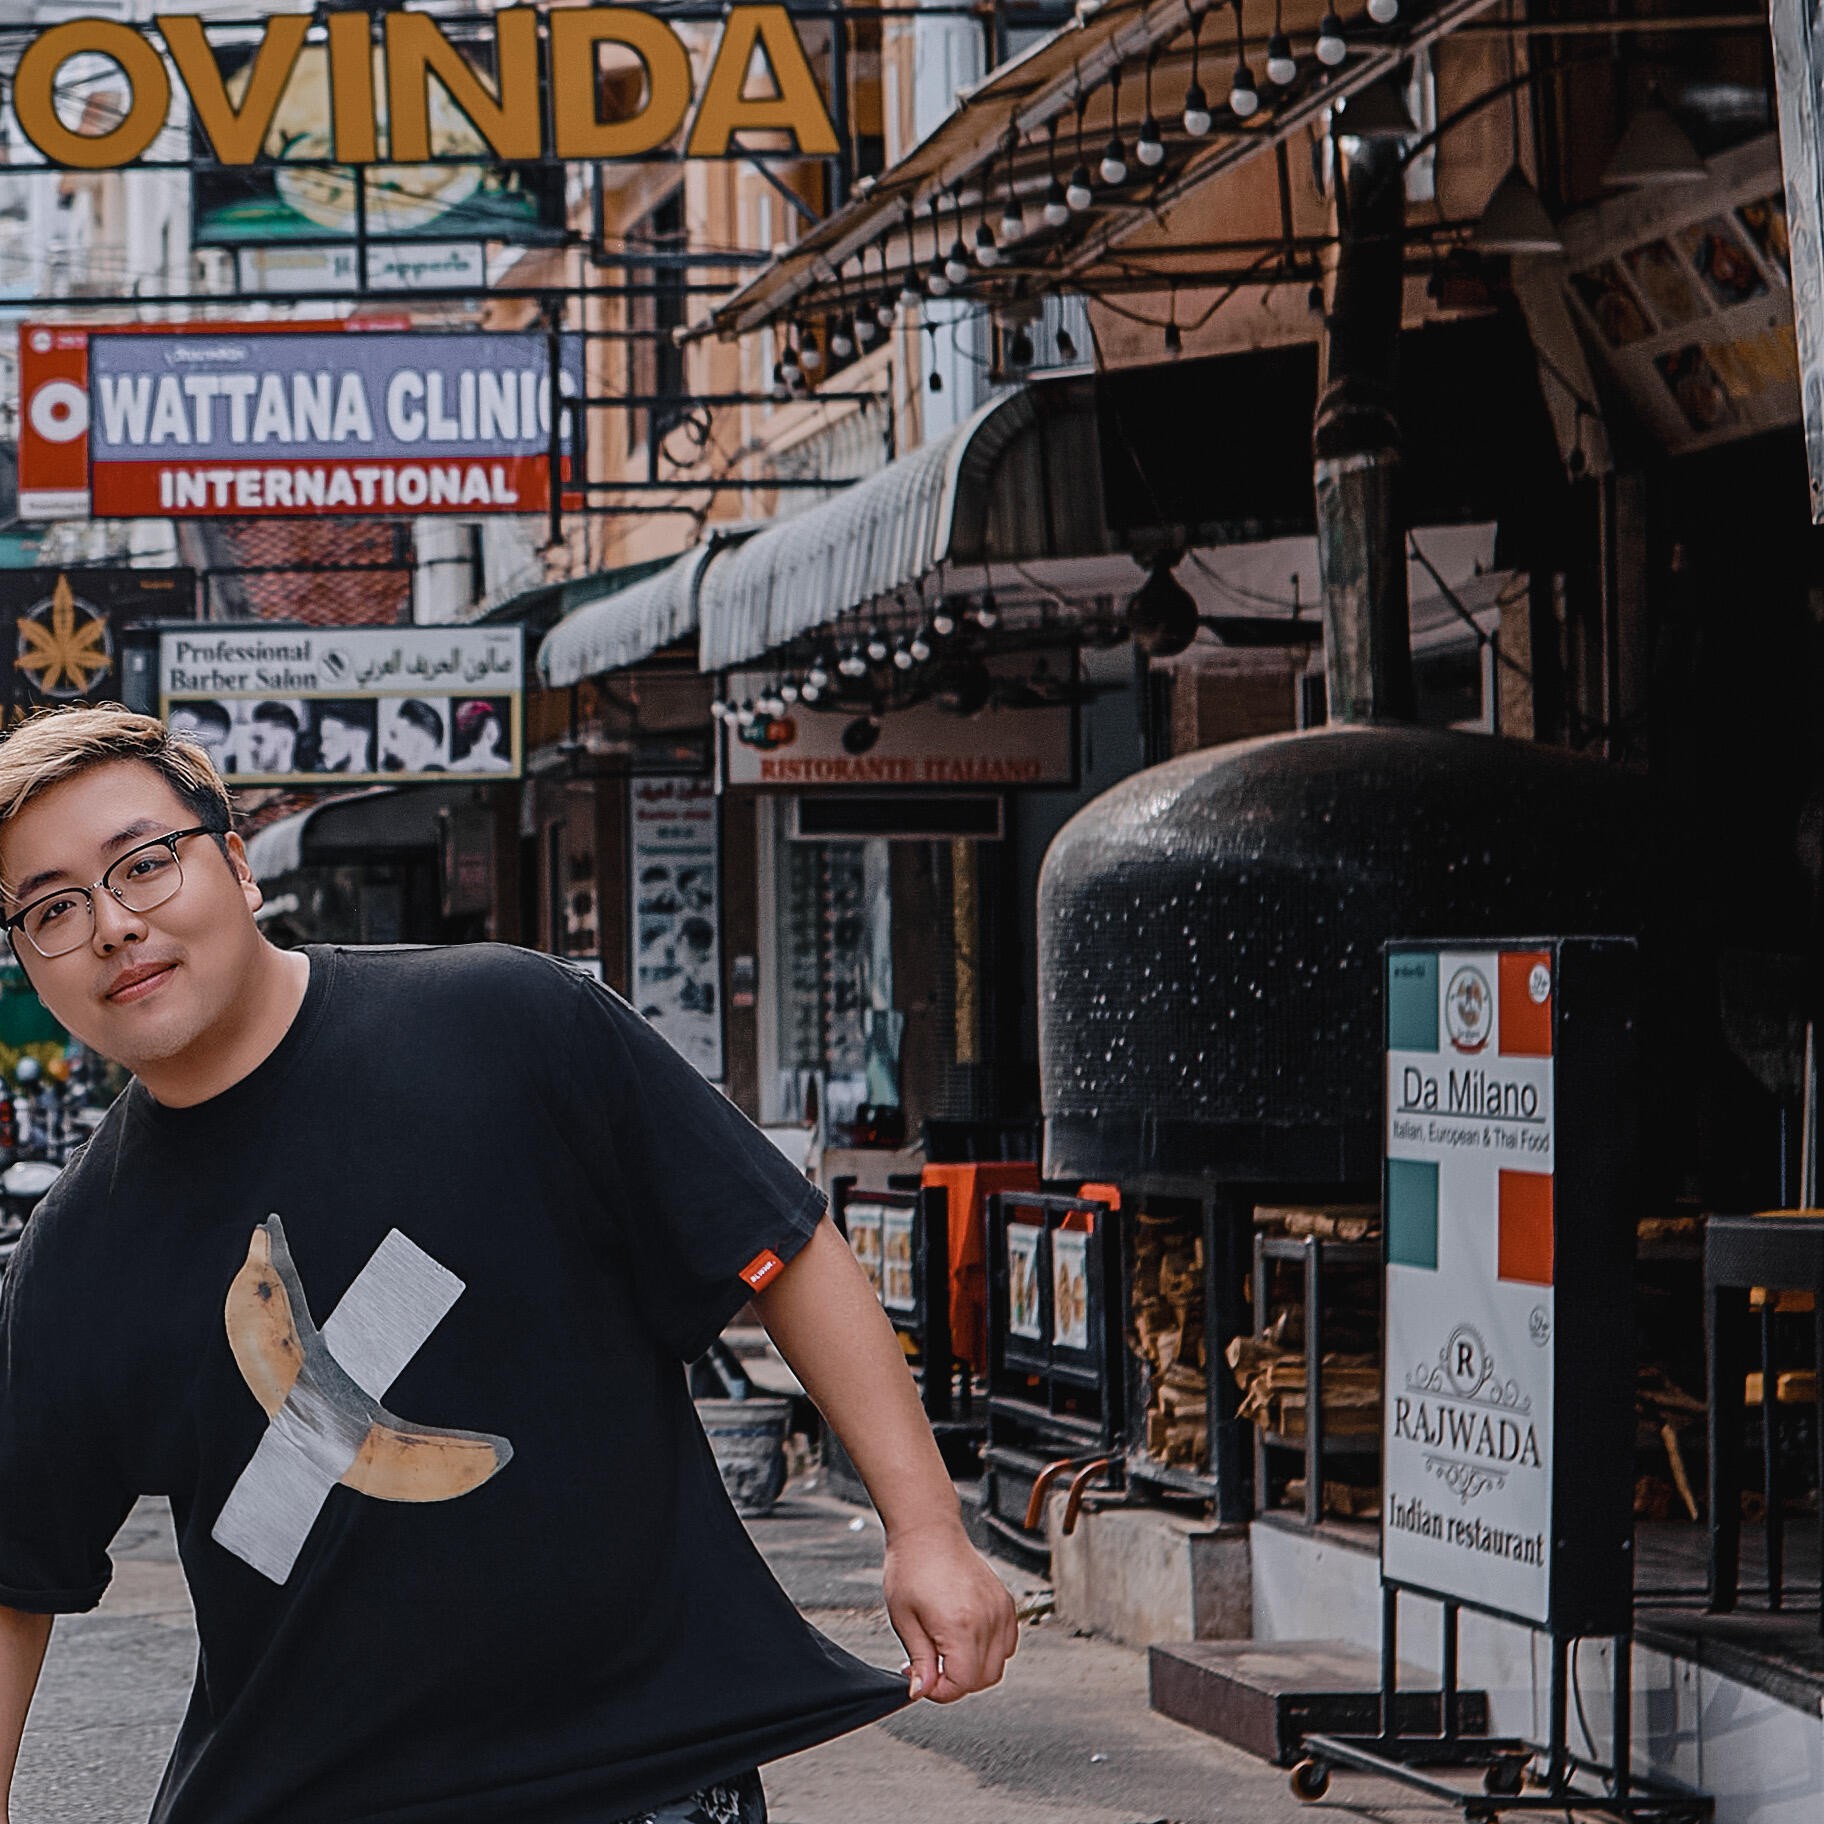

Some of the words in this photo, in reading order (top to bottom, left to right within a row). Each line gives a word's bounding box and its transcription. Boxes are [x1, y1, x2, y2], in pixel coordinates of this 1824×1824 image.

[100, 374, 374, 445] WATTANA
[160, 467, 518, 509] INTERNATIONAL
[176, 640, 311, 665] Professional
[171, 669, 251, 690] Barber
[256, 668, 319, 690] Salon
[1404, 1066, 1438, 1110] Da
[1449, 1069, 1538, 1119] Milano
[1428, 1122, 1480, 1150] European
[1483, 1129, 1492, 1148] &
[1493, 1128, 1518, 1148] Thai
[1521, 1131, 1551, 1154] Food
[1456, 1342, 1475, 1379] R
[1394, 1396, 1542, 1469] RAJWADA
[1388, 1492, 1443, 1544] Indian
[1445, 1516, 1545, 1569] restaurant
